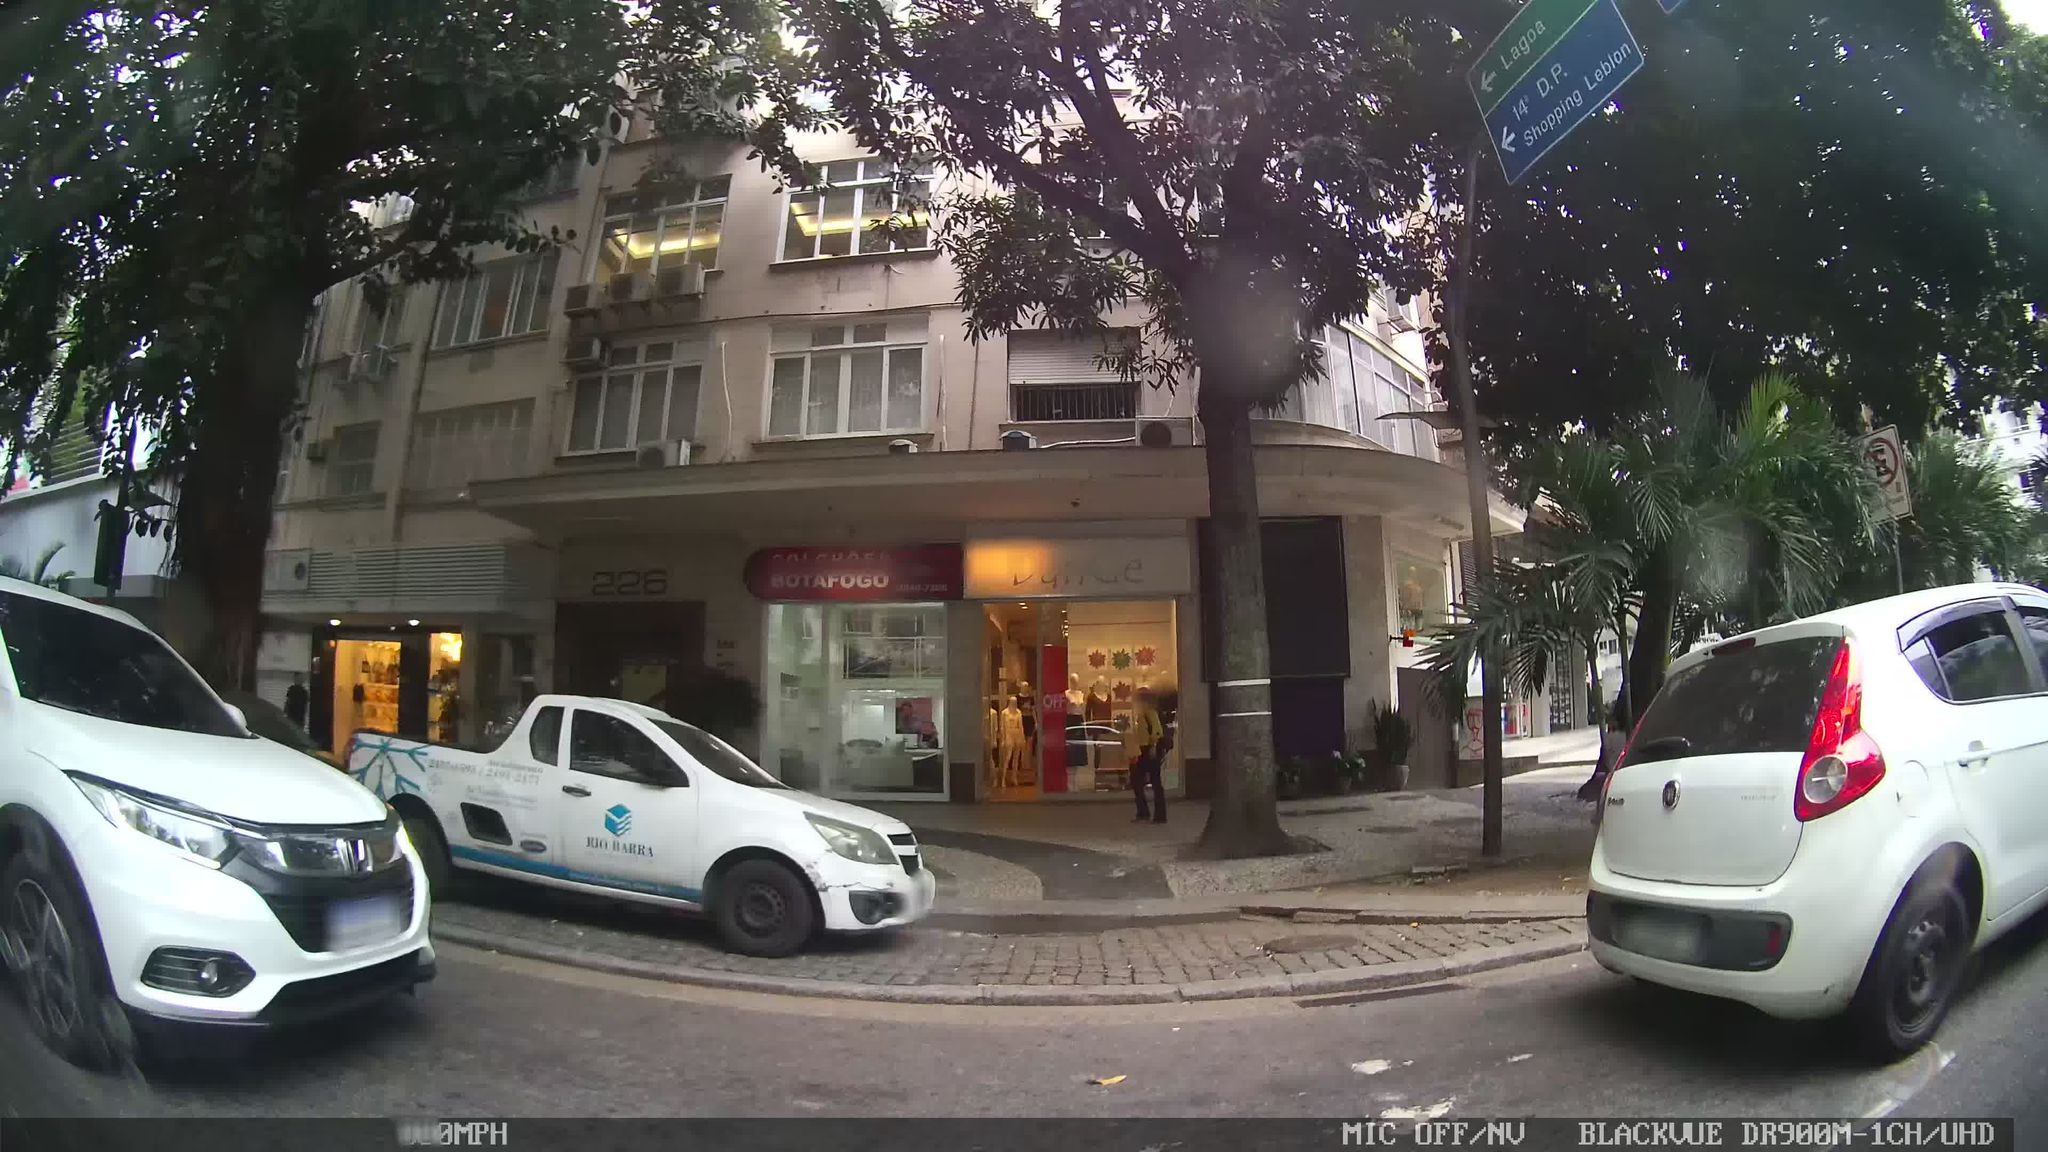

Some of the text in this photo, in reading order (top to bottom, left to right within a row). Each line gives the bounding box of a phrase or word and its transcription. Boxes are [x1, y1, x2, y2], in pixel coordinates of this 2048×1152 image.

[1500, 20, 1546, 70] Lagoa
[1523, 43, 1631, 147] Shopping Leblon
[592, 569, 668, 595] 226
[770, 572, 889, 589] BOTAFOGO
[586, 836, 654, 857] RIO BARRA
